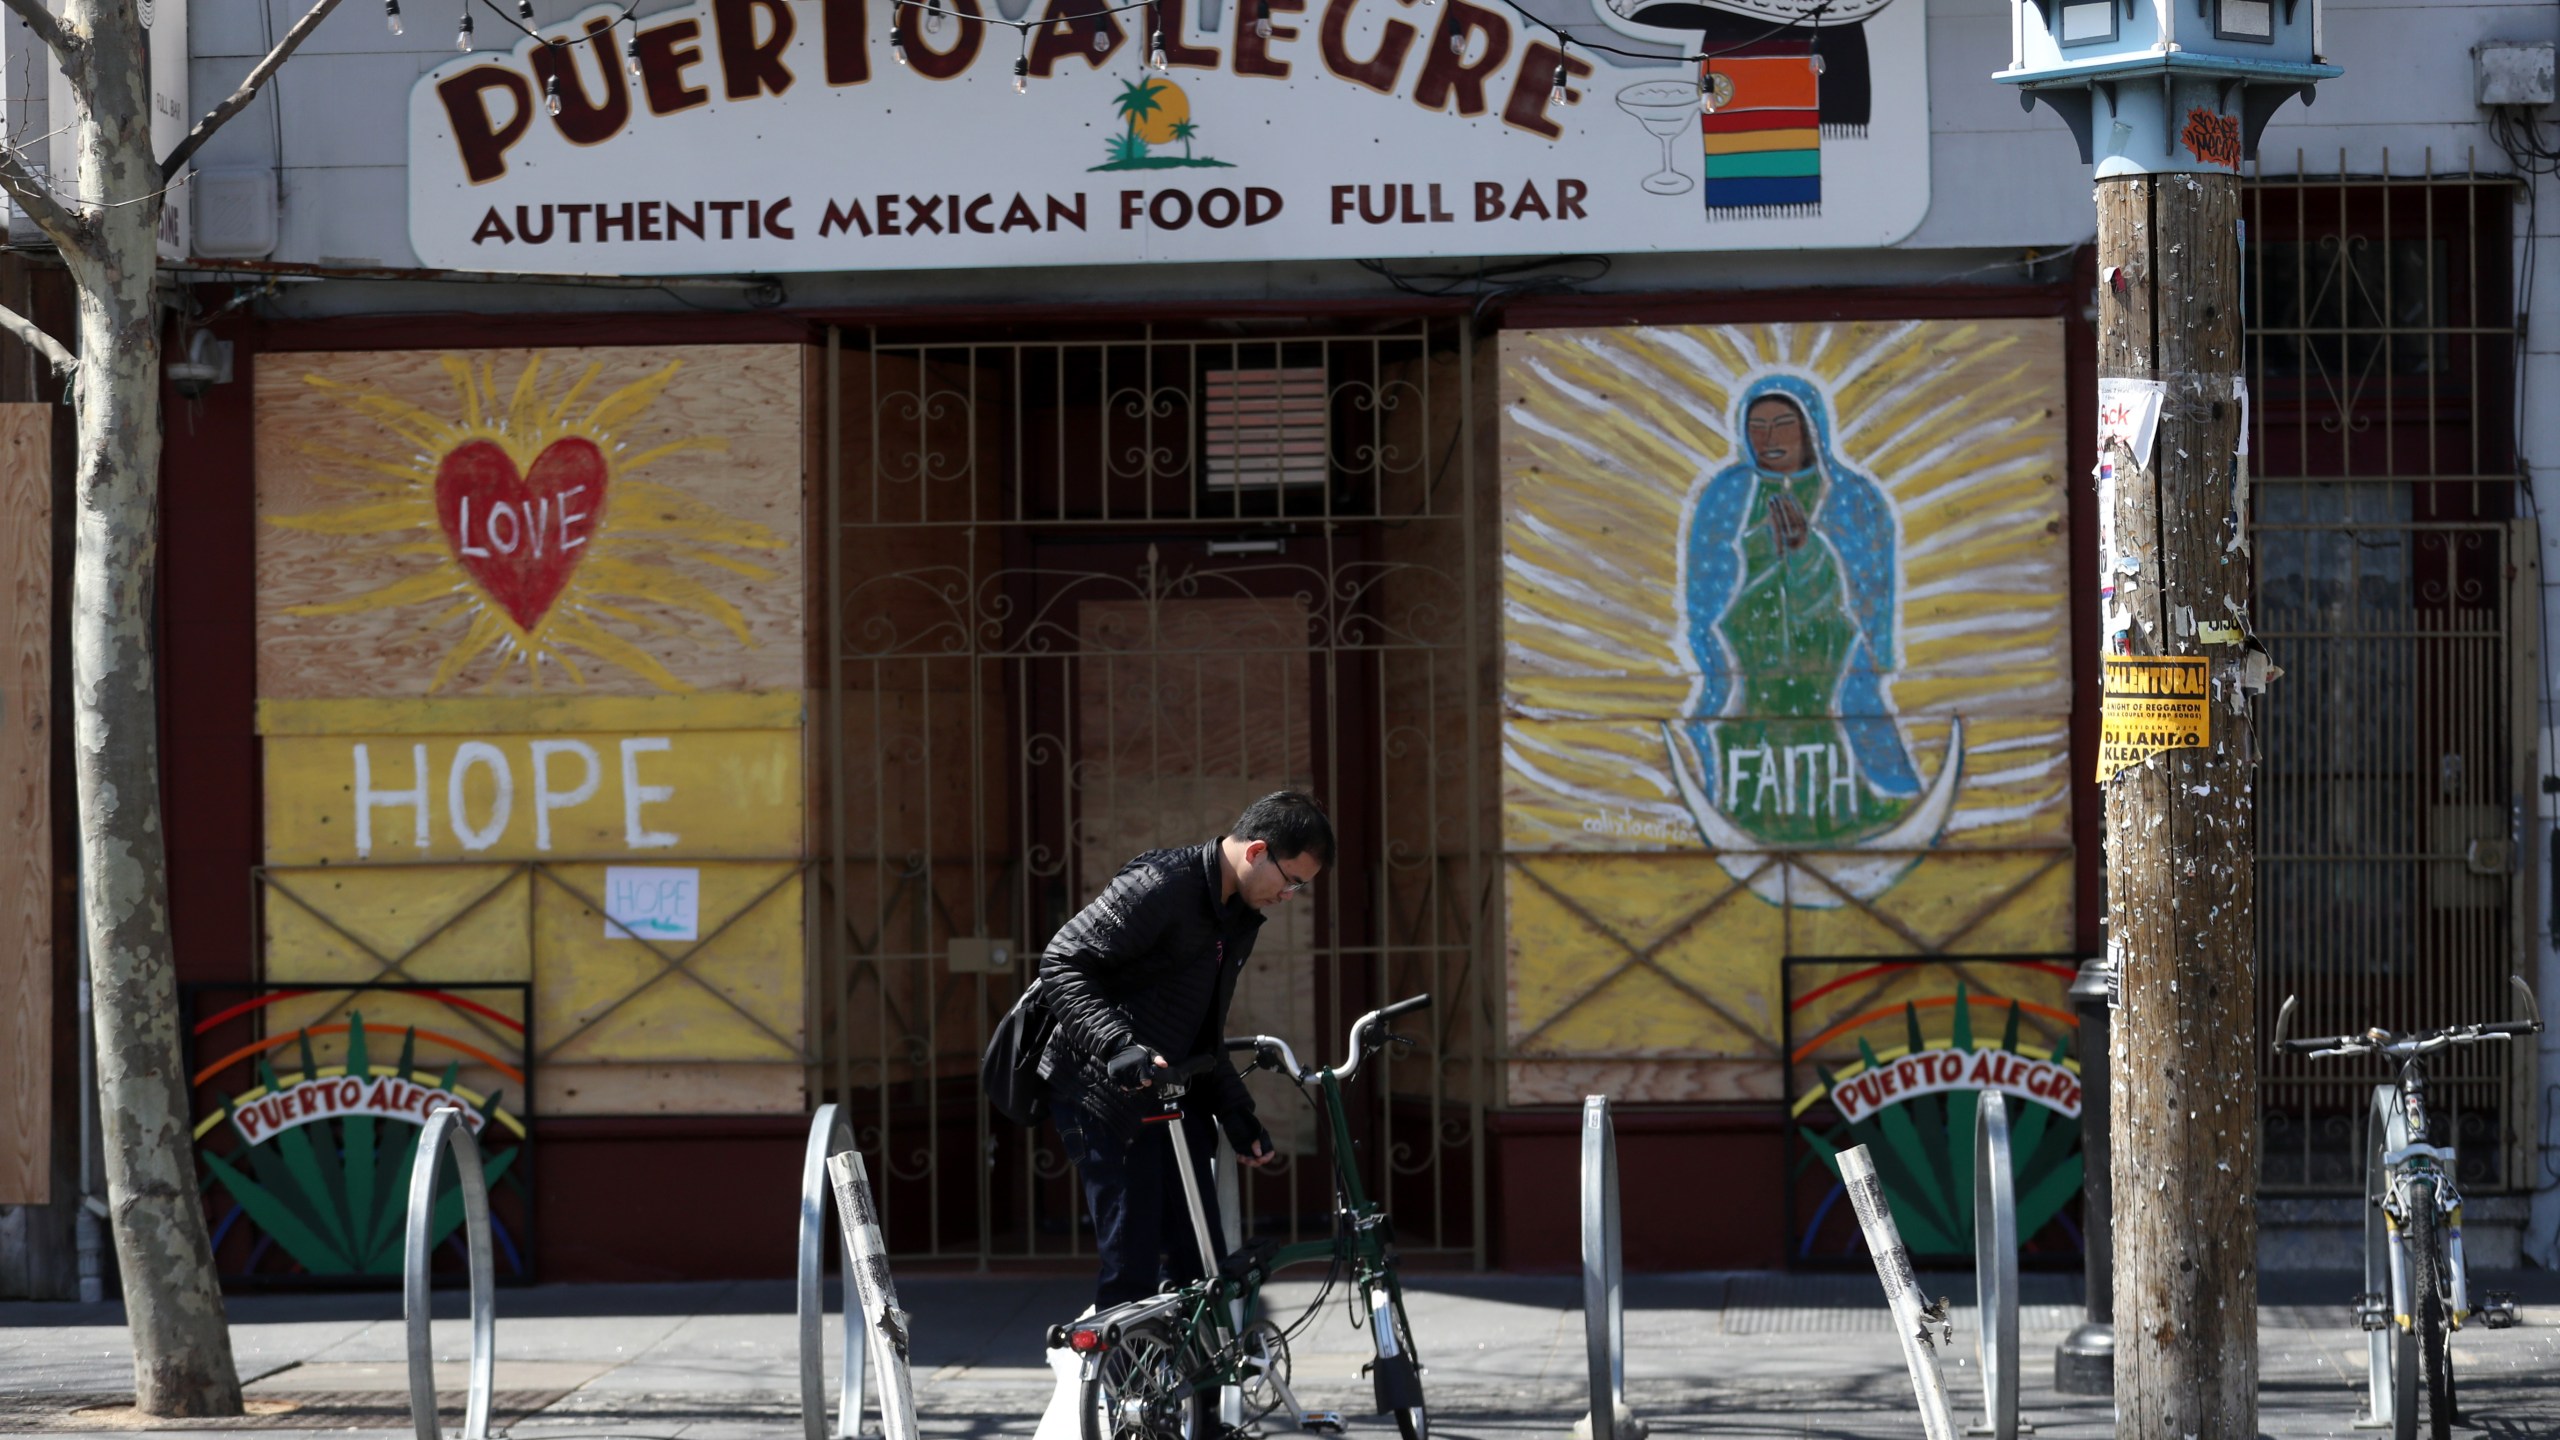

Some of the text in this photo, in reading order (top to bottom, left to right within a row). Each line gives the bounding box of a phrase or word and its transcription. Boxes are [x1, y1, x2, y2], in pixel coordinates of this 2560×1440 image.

[1028, 0, 1594, 140] ALEGRE
[472, 178, 1590, 246] AUTHENTIC MEXICAN FOOD FULL BAR
[459, 484, 588, 558] LOVE
[2105, 731, 2120, 744] DJ
[2133, 703, 2143, 711] OF
[352, 737, 680, 857] HOPE
[1727, 743, 1858, 819] FAITH
[615, 879, 691, 918] HOPE
[236, 1080, 361, 1138] PUERTO
[1836, 1052, 2081, 1116] PUERTO ALEGRE
